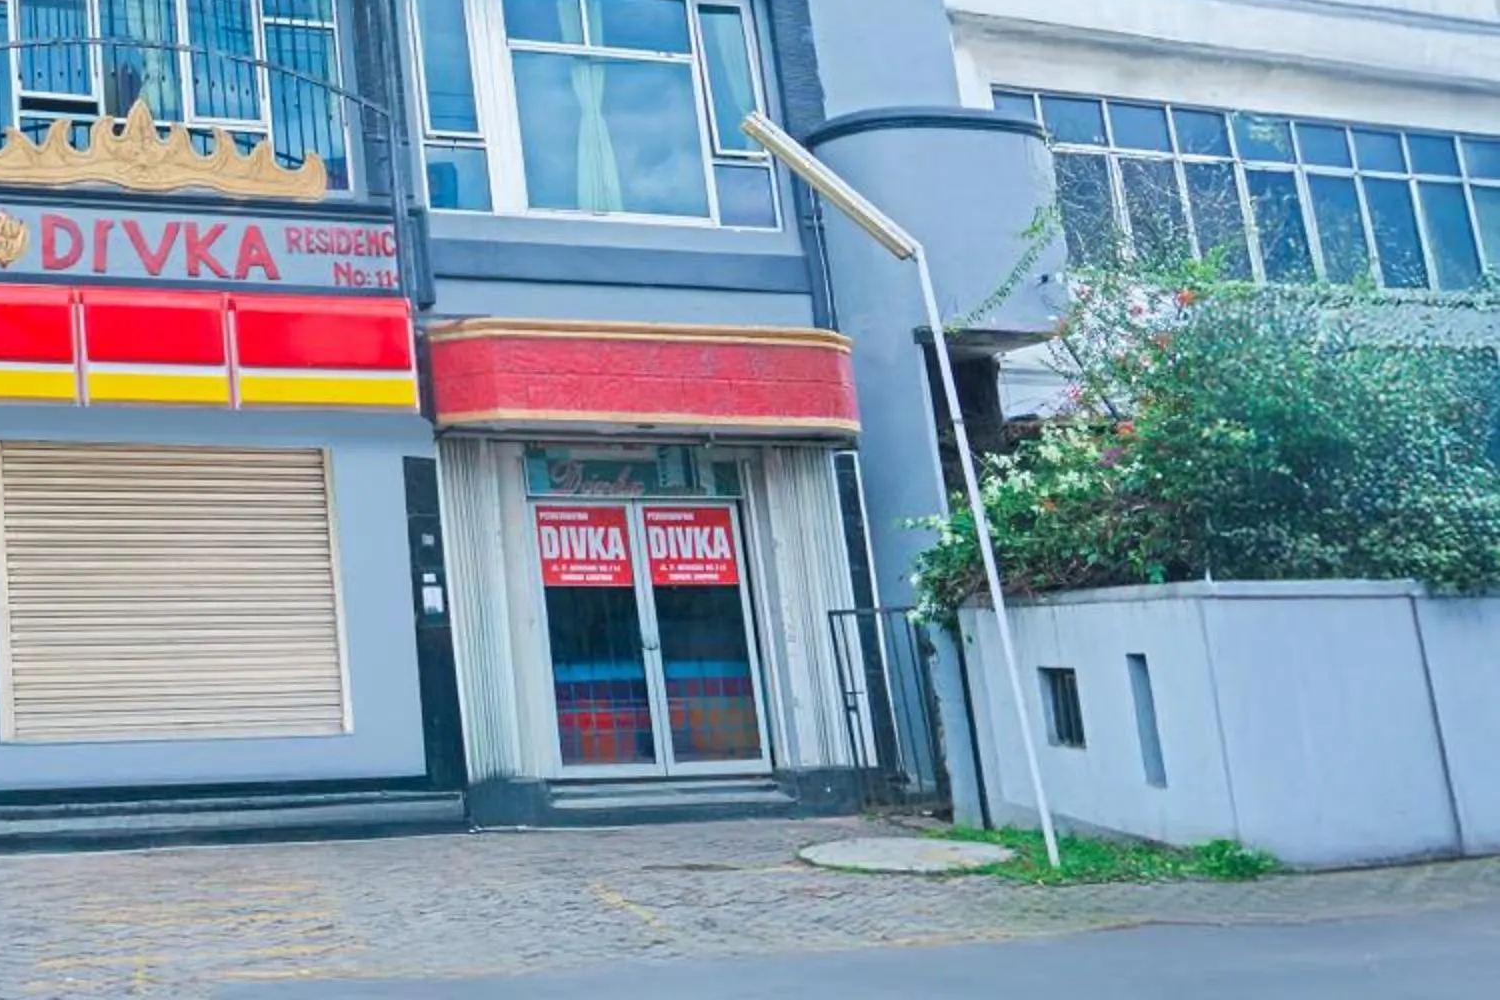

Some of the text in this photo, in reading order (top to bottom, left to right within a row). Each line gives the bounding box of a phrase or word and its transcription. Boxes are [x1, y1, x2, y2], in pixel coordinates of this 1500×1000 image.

[40, 212, 281, 281] DIVKA
[284, 225, 396, 258] RESIDENC
[540, 526, 627, 560] DIVKA
[647, 526, 732, 560] DIVKA
